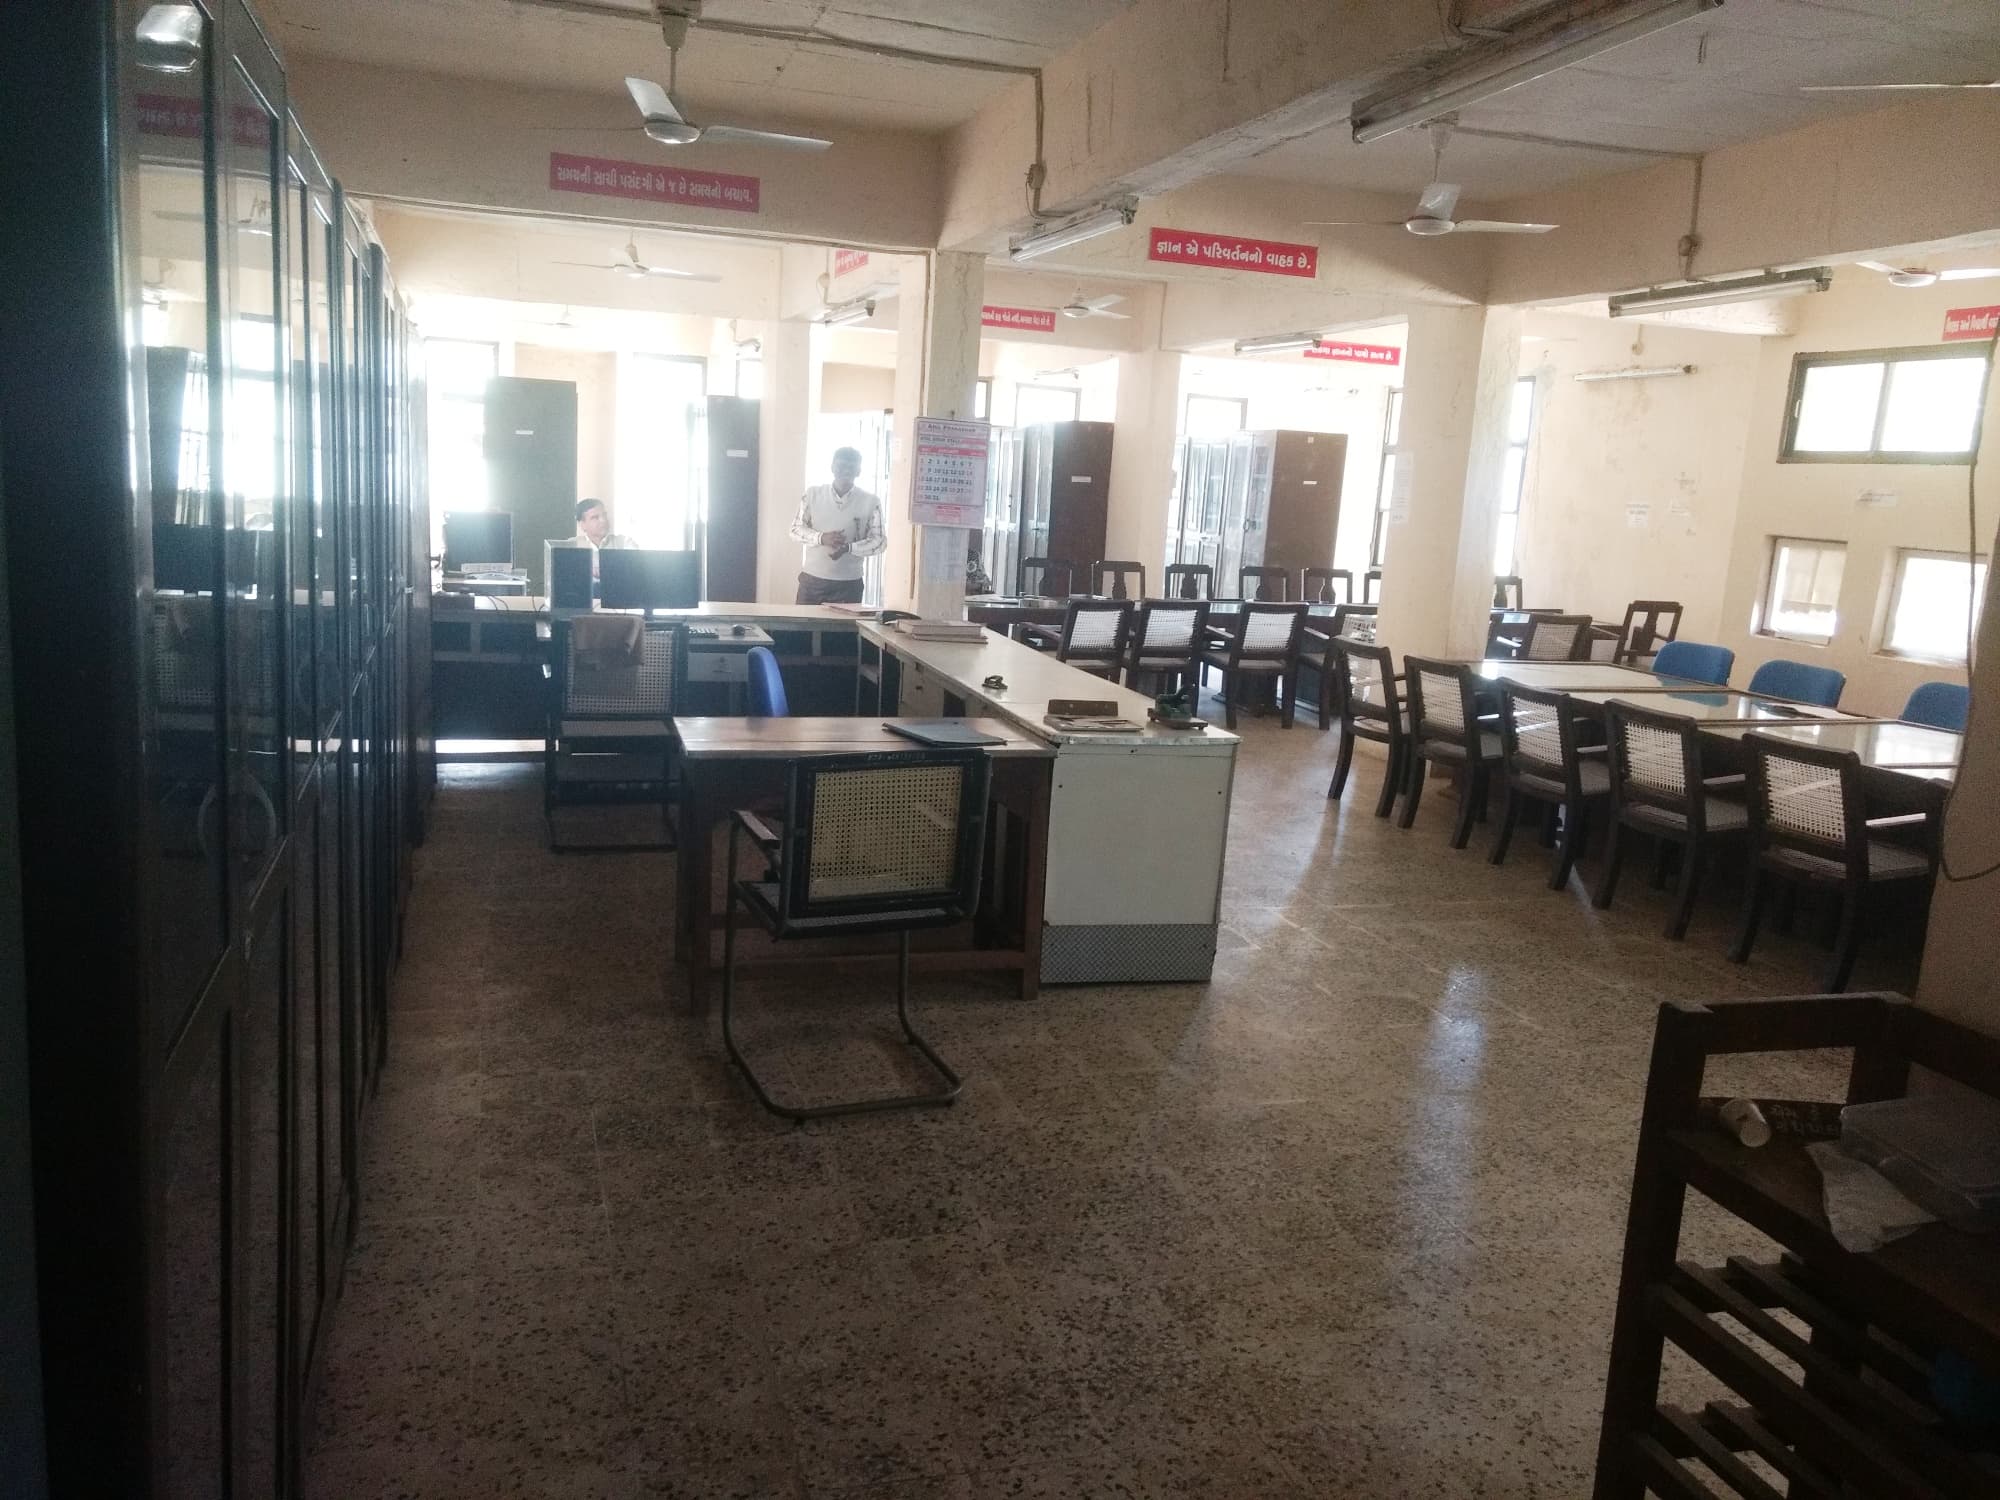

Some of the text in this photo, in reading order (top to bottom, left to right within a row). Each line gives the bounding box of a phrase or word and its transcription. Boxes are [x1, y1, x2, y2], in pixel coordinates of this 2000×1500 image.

[557, 165, 591, 184] સમયની
[620, 170, 652, 192] પસંદગી
[656, 173, 665, 192] એ
[679, 176, 686, 195] છે
[689, 178, 721, 199] સમયનો
[1156, 239, 1312, 270] જ્ઞાન એ પરિવર્તનનો વાહક છે.
